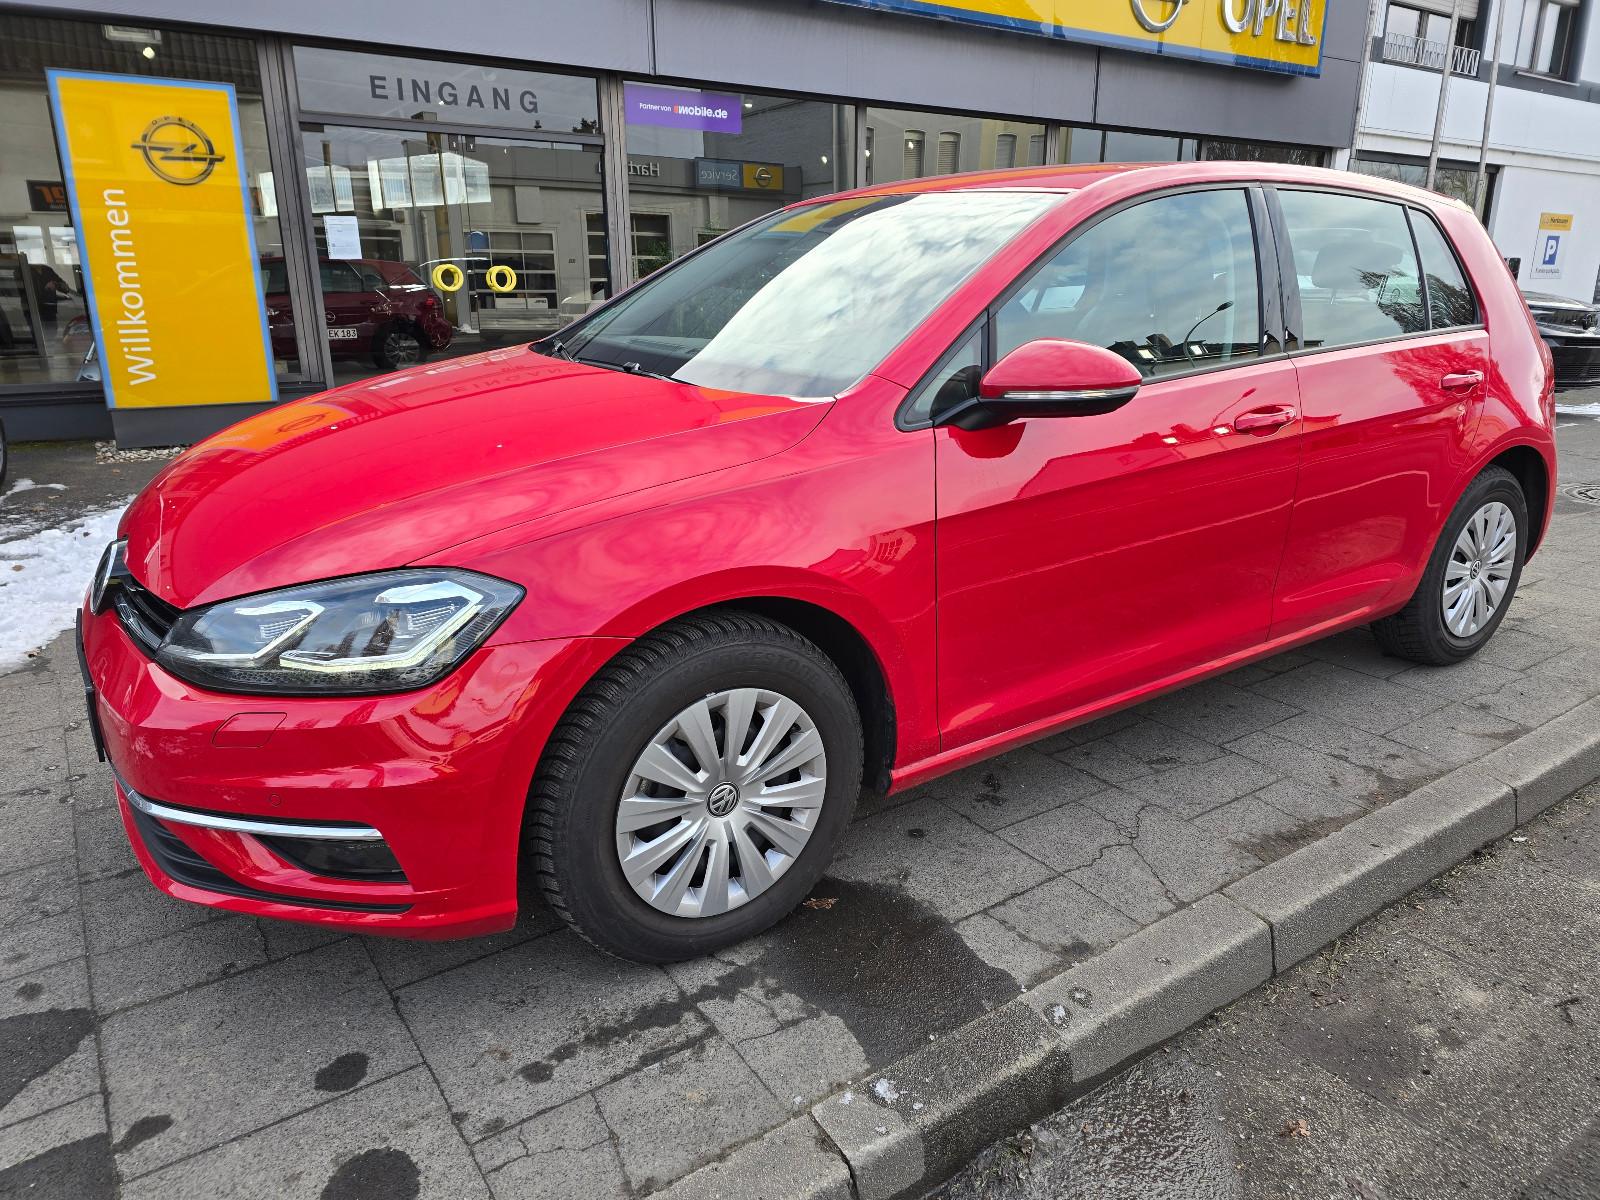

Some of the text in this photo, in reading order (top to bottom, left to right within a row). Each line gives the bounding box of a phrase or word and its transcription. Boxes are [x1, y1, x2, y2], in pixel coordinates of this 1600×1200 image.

[1222, 0, 1317, 45] OPEL
[369, 75, 538, 114] EINGANG
[639, 102, 660, 111] Partner
[678, 105, 728, 119] mobile.de
[1544, 239, 1557, 261] P
[103, 188, 158, 386] Willkommen
[328, 329, 357, 338] EK 183
